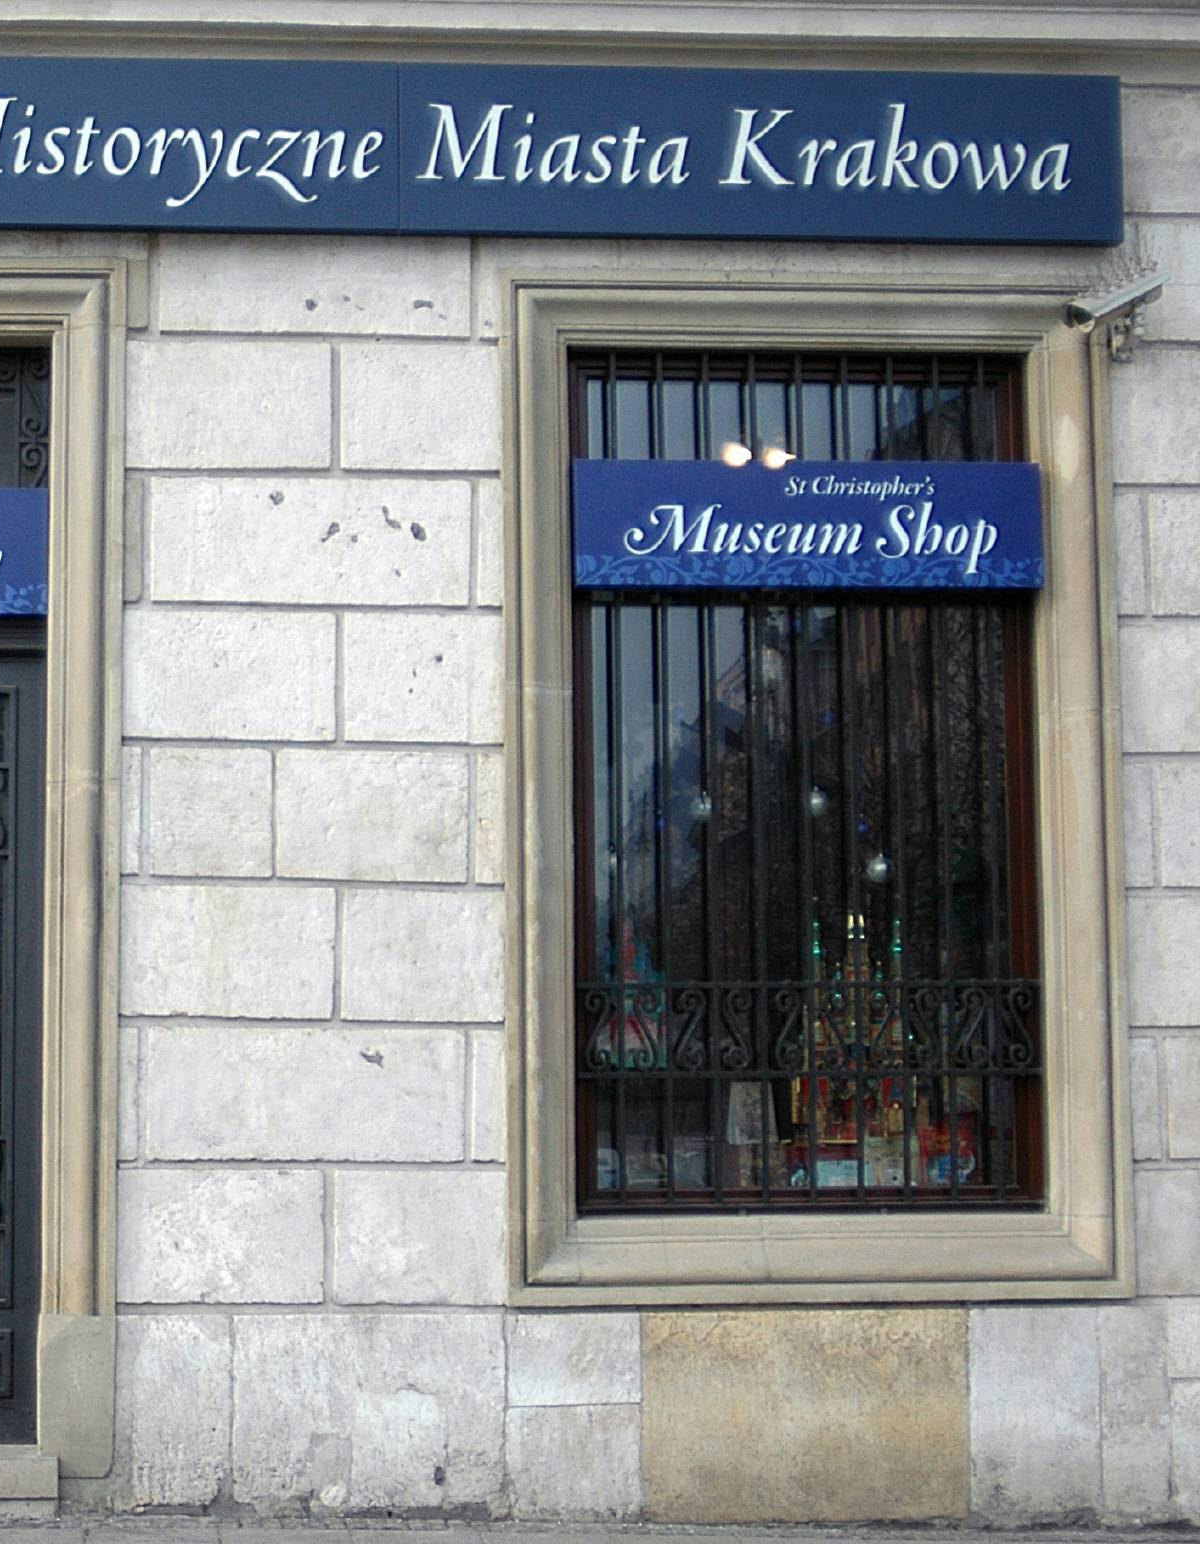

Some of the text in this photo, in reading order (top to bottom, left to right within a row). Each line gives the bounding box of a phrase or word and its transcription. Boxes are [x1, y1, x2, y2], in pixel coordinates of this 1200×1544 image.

[416, 103, 690, 185] Miasta
[719, 104, 1072, 192] Krakowa
[785, 476, 805, 497] St
[623, 501, 998, 574] Museum Shop
